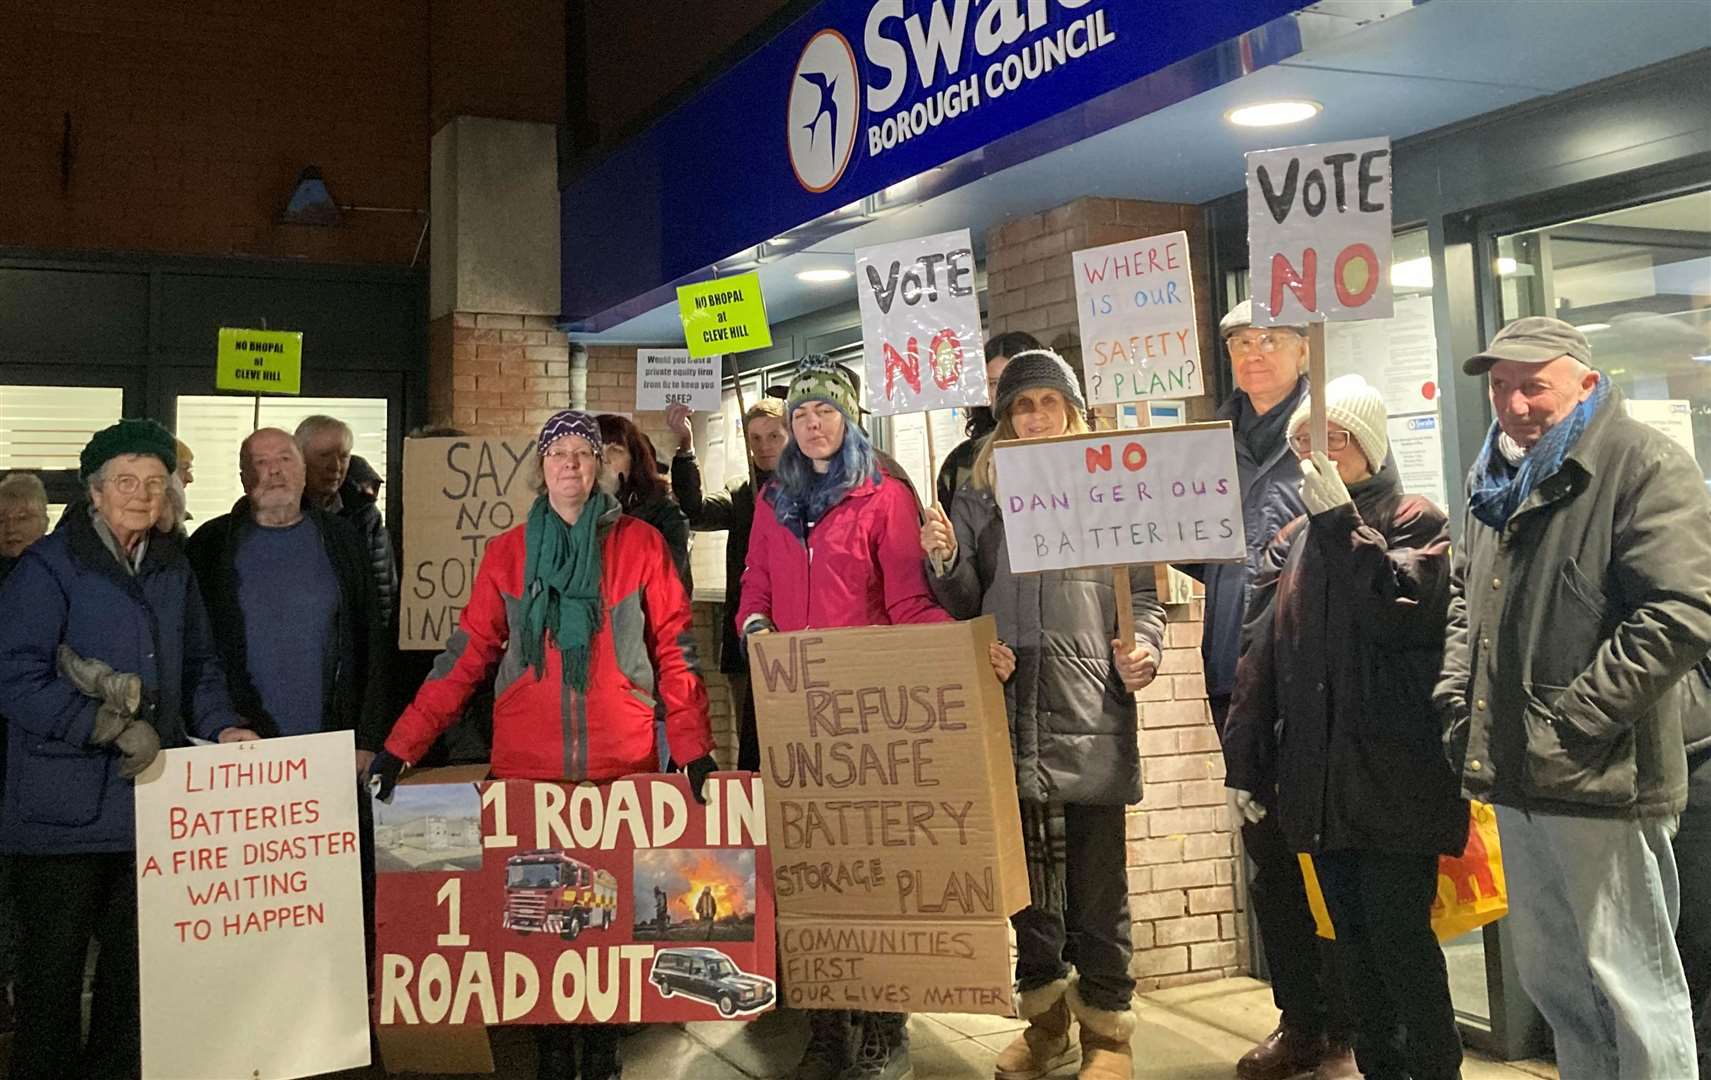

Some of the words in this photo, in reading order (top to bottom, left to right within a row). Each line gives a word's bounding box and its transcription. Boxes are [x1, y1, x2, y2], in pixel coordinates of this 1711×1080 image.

[864, 0, 1091, 112] Swa
[868, 74, 980, 157] BOROUGH
[985, 9, 1116, 98] COUNCIL
[1256, 149, 1389, 225] VOTE
[866, 251, 974, 314] VOTE
[1084, 242, 1180, 284] WHERE
[1270, 242, 1380, 318] NO
[695, 296, 708, 309] NO
[708, 289, 744, 307] BHOPAL
[717, 312, 727, 323] at
[1091, 295, 1113, 317] IS
[1135, 281, 1182, 308] OUR
[235, 341, 247, 351] NO
[249, 342, 284, 353] BHOPAL
[703, 328, 729, 343] CLEVE
[729, 324, 749, 339] HILL
[1094, 328, 1190, 367] SAFETY
[235, 369, 260, 380] CLEVE
[263, 371, 281, 382] HILL
[254, 357, 263, 367] at
[645, 368, 672, 377] private
[673, 368, 696, 377] equity
[698, 368, 713, 376] firm
[882, 328, 965, 401] NO
[643, 380, 661, 389] from
[665, 394, 692, 404] SAFE?
[442, 440, 537, 500] SAY
[1085, 442, 1148, 474] NO
[455, 500, 514, 530] NO
[754, 636, 830, 693] WE
[807, 684, 968, 738] REFUSE
[186, 758, 308, 793] LITHIUM
[768, 739, 940, 789] UNSAFE
[169, 799, 320, 840] BATTERIES
[482, 782, 518, 848] 1
[534, 780, 688, 850] ROAD
[705, 778, 767, 846] IN
[780, 800, 975, 849] BATTERY
[142, 856, 163, 878] A
[172, 847, 228, 874] FIRE
[243, 831, 356, 866] DISASTER
[187, 871, 308, 905] WAITING
[775, 858, 884, 897] STORAGE
[896, 866, 995, 913] PLAN
[174, 919, 211, 943] TO
[224, 903, 325, 937] HAPPEN
[436, 878, 470, 946] 1
[783, 927, 976, 957] COMMUNITIES
[380, 951, 541, 1024] ROAD
[552, 944, 655, 1022] OUT
[787, 957, 864, 981] FIRST
[791, 985, 835, 1004] OUR
[845, 984, 910, 1003] LIVES
[923, 987, 1009, 1006] MATTER
